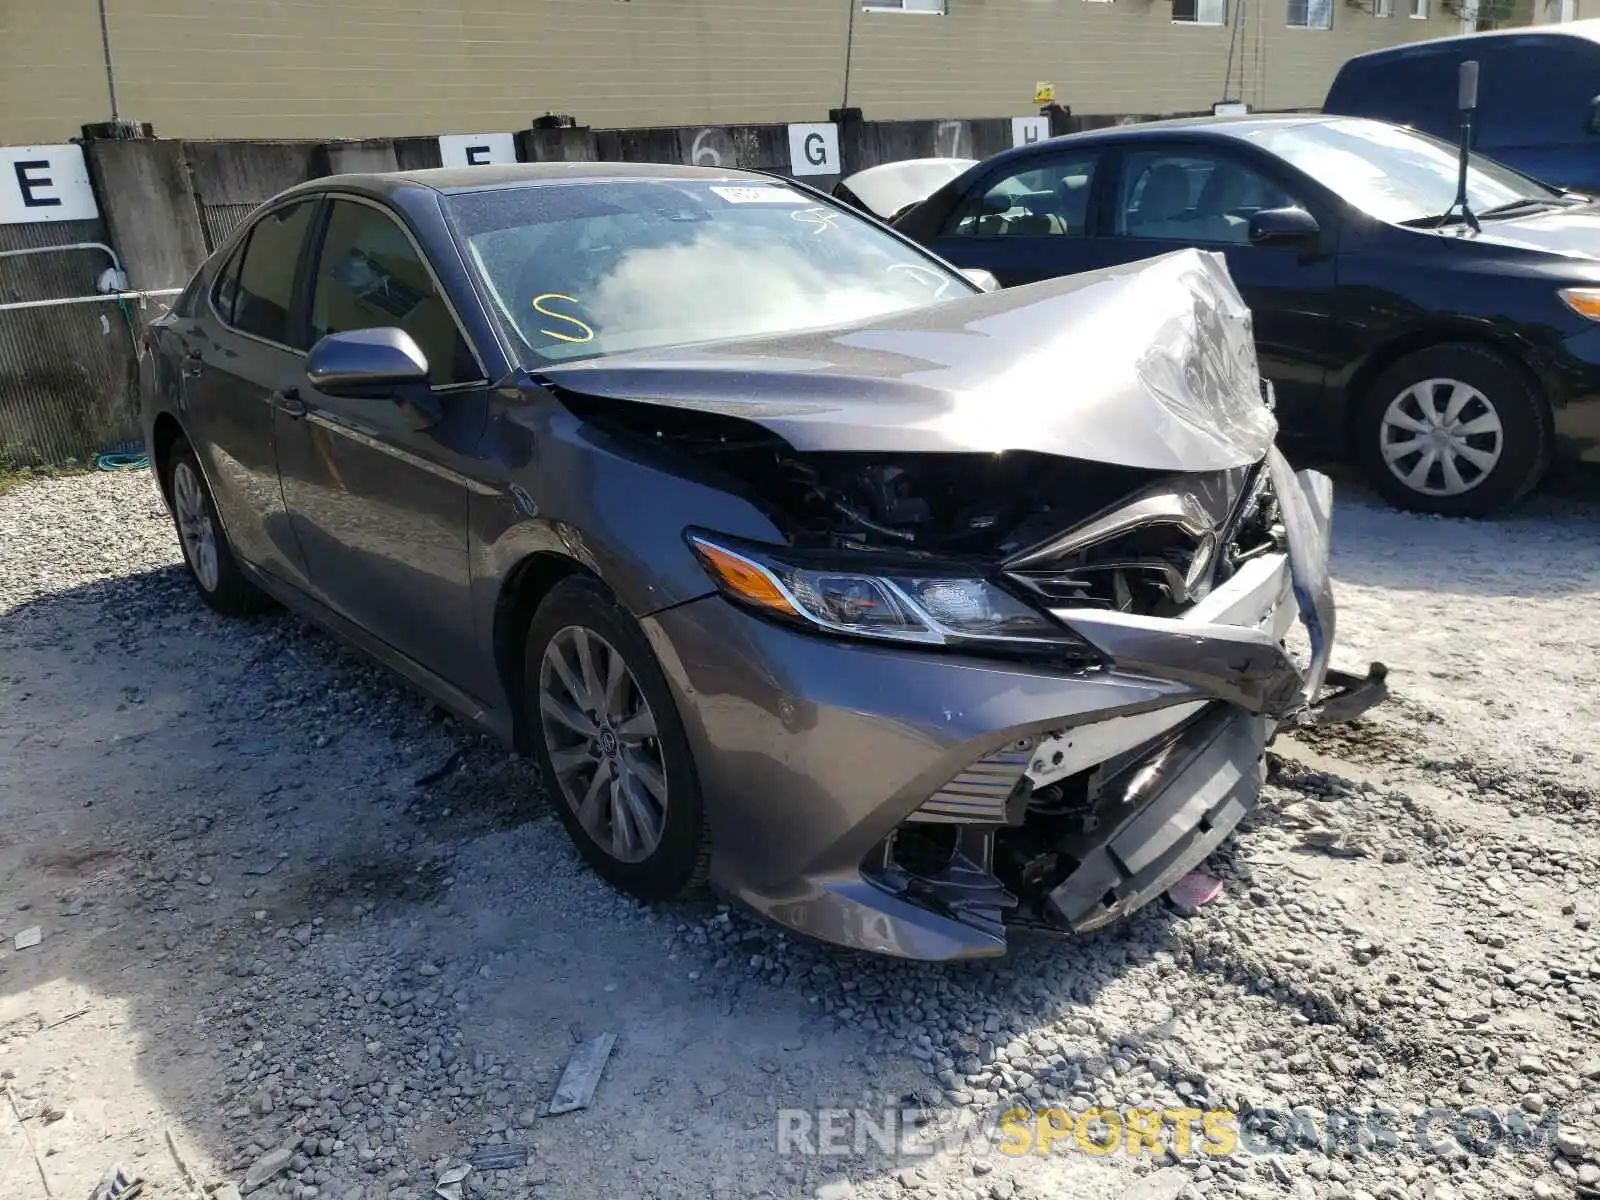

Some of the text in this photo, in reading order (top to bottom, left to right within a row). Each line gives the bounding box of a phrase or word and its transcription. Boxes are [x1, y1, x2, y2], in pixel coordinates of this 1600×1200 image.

[804, 132, 827, 166] G
[14, 160, 63, 207] E
[532, 293, 595, 343] S
